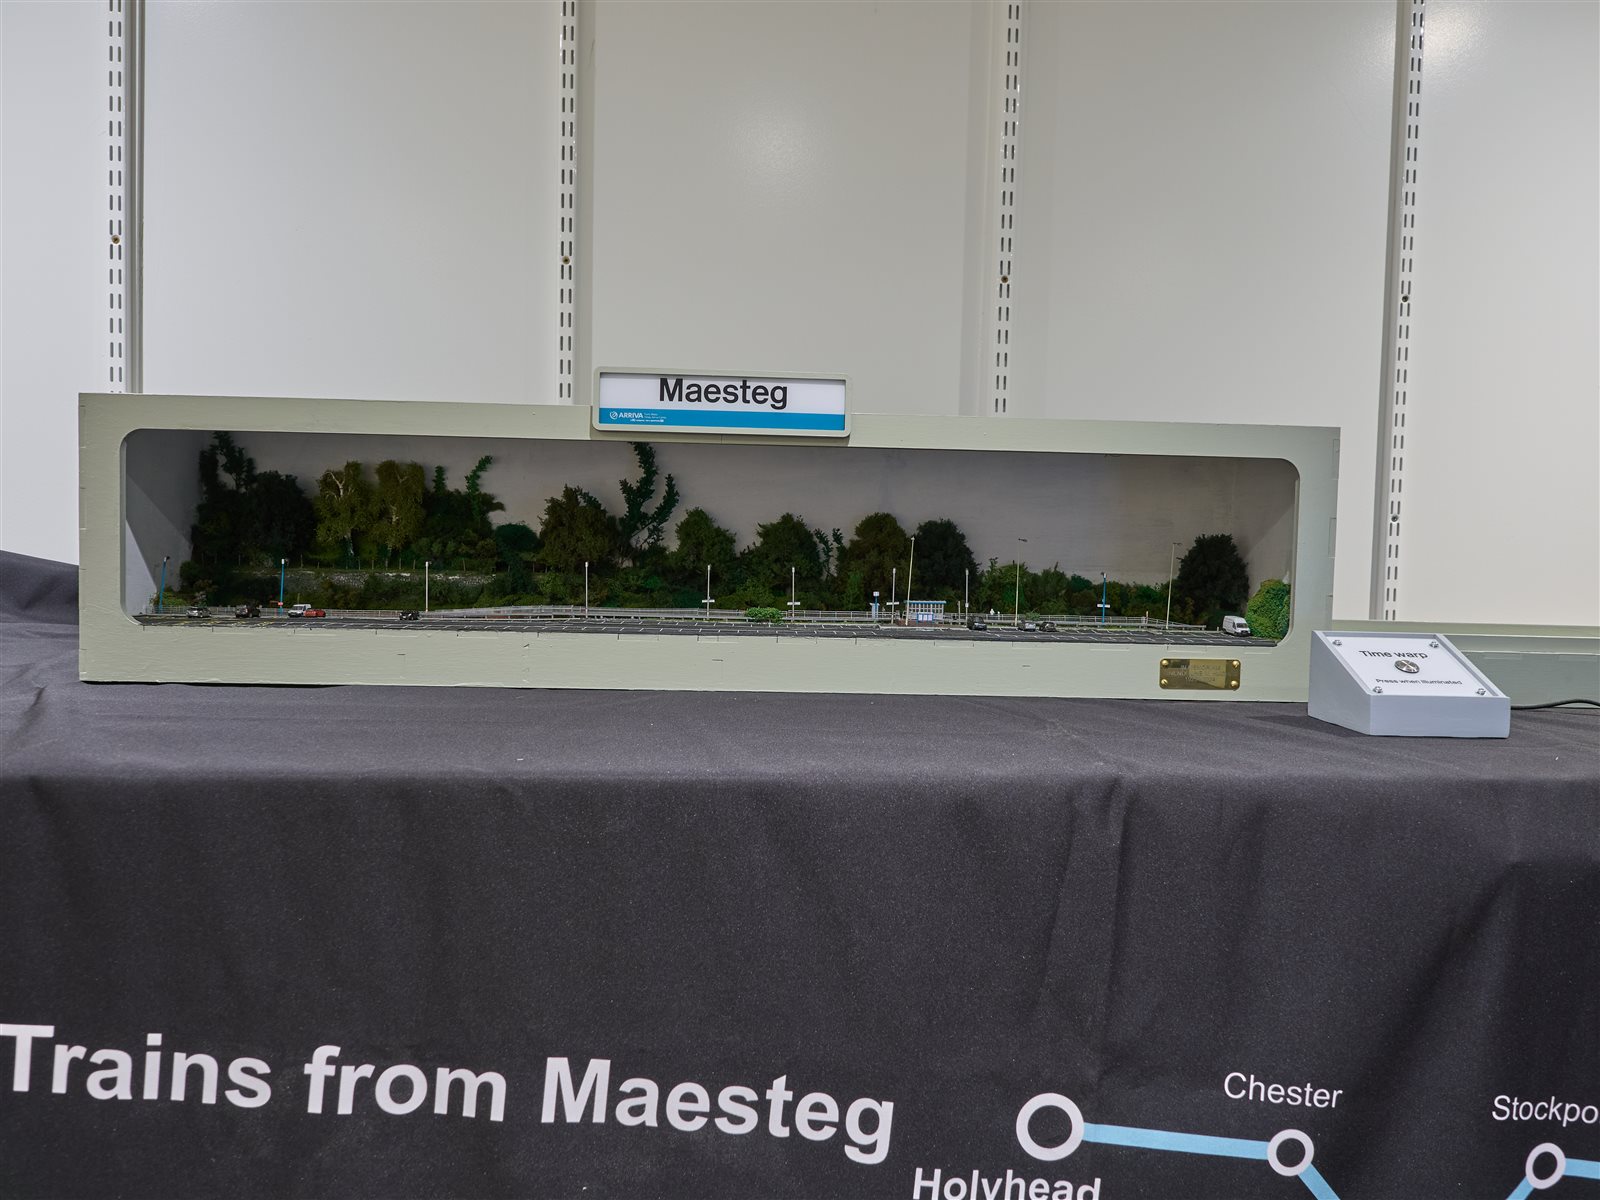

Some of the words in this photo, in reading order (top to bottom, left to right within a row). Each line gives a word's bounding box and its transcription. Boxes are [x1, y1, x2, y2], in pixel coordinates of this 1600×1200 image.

[659, 377, 788, 410] Maesteg
[1358, 650, 1393, 658] Time
[1394, 651, 1429, 659] warp
[0, 1024, 271, 1109] Trains
[304, 1045, 507, 1122] from
[541, 1057, 895, 1165] Maesteg
[1223, 1071, 1343, 1108] Chester
[1491, 1094, 1600, 1128] Stockpo
[912, 1167, 1102, 1200] Holyhead
